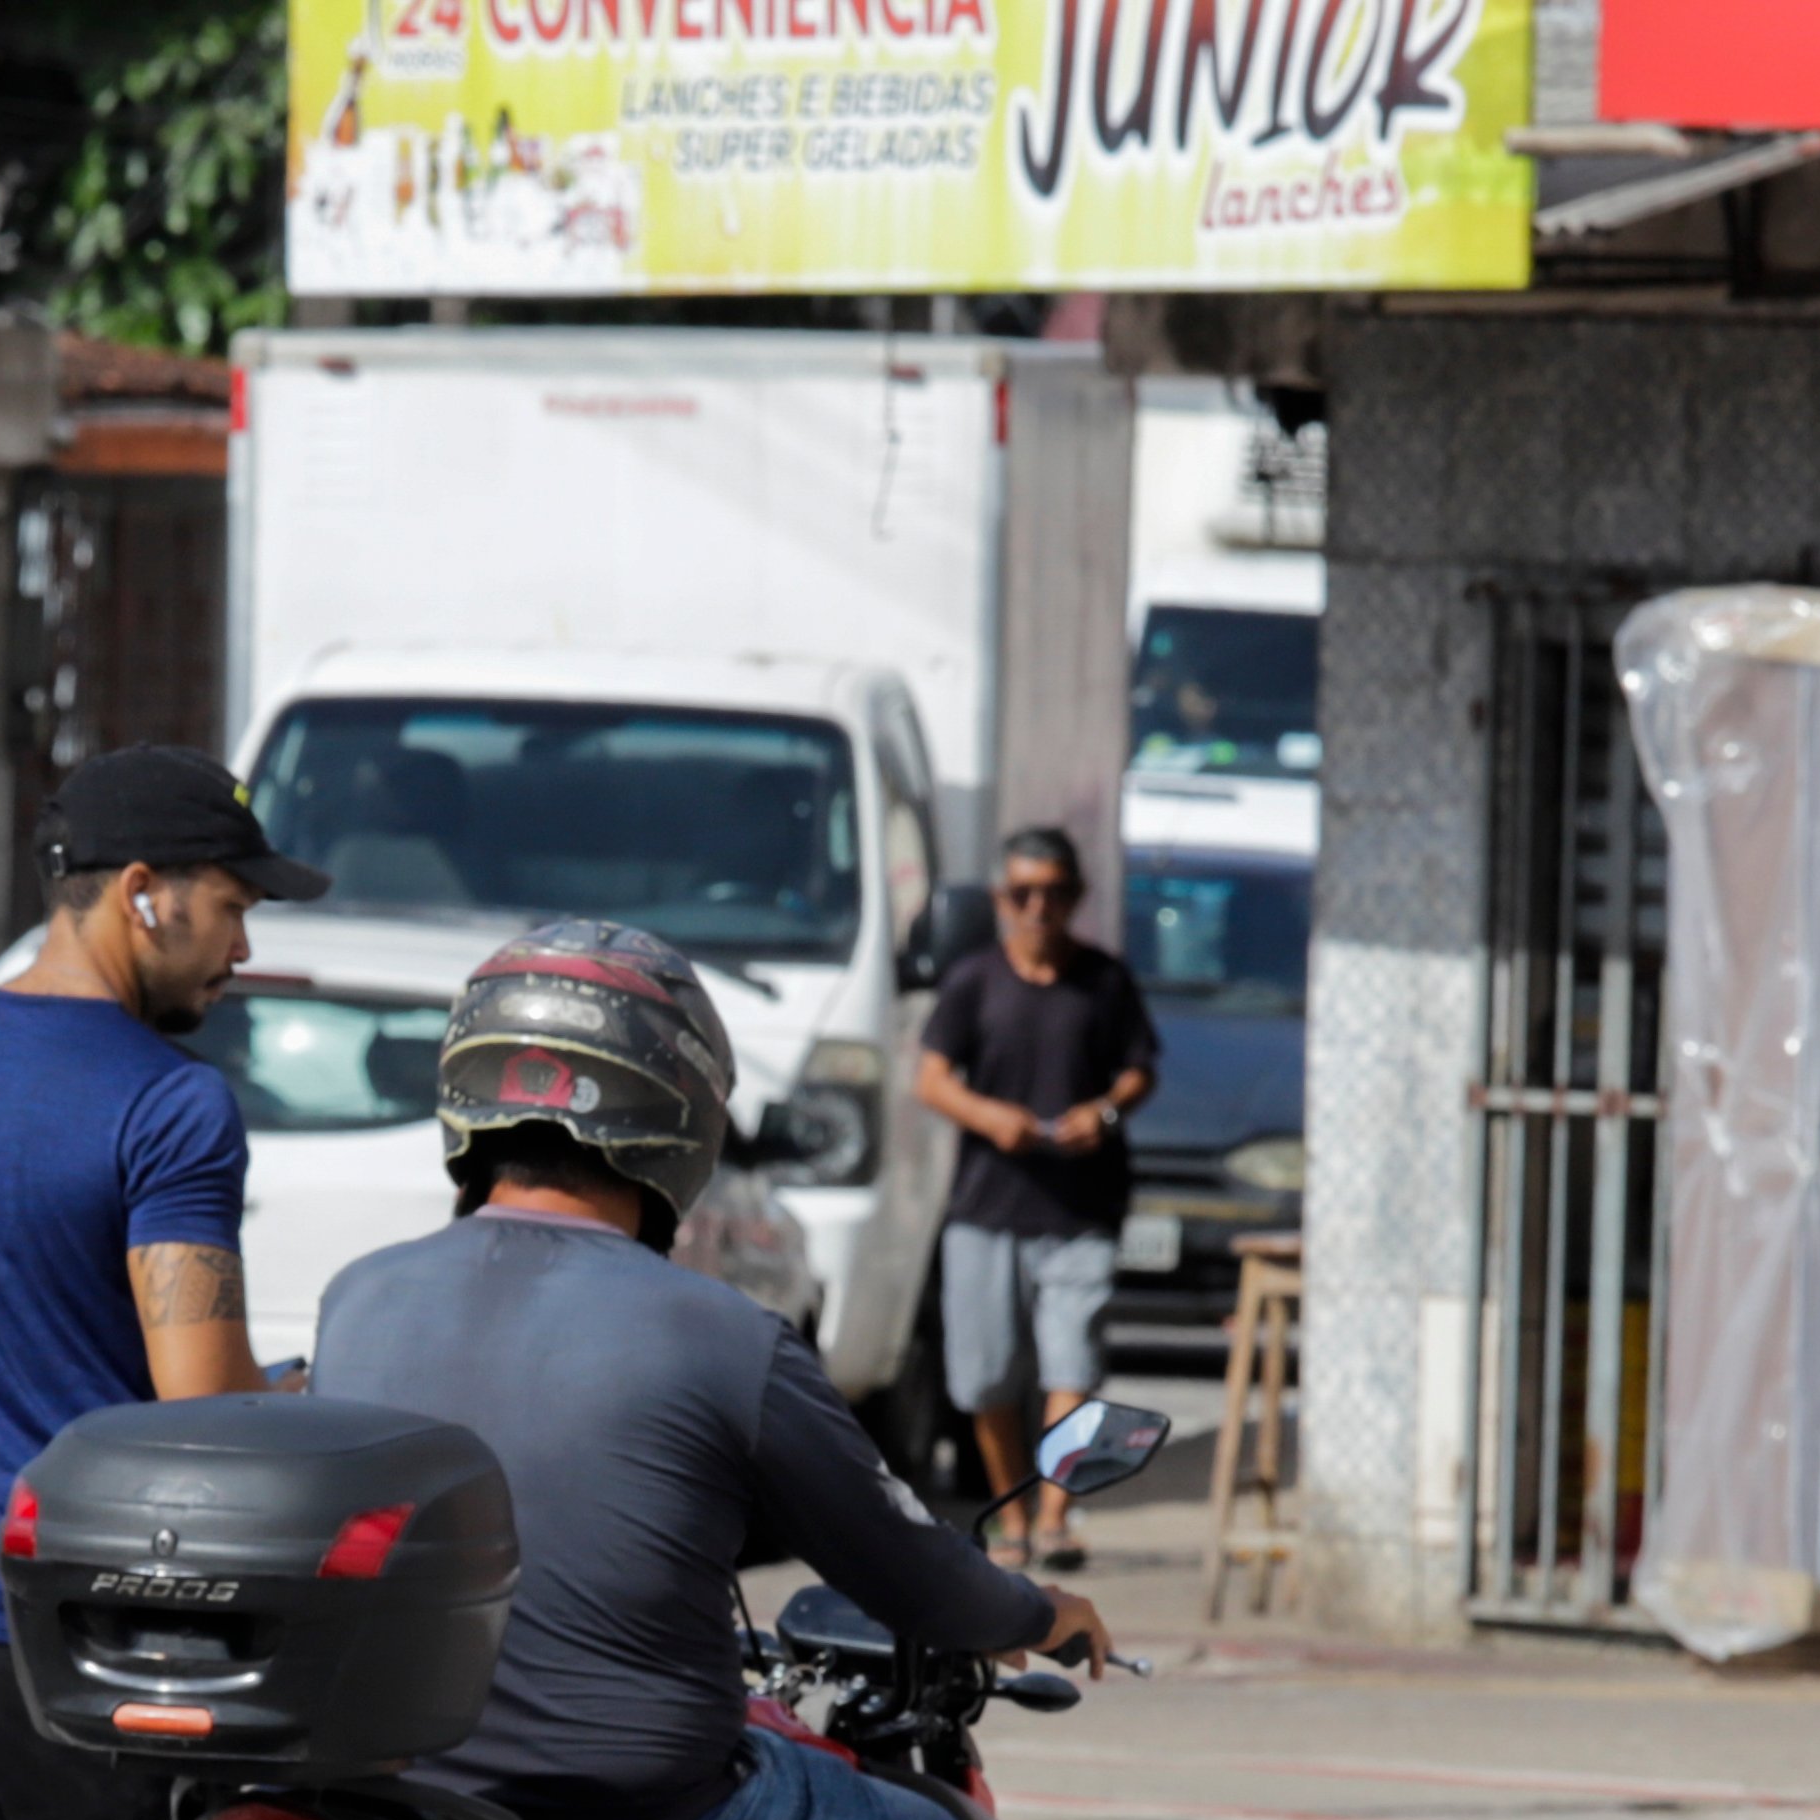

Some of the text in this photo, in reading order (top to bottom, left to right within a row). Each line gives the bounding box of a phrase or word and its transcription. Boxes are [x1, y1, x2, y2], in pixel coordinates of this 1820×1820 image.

[622, 72, 994, 119] LANCHES E BEBIDAS
[675, 126, 979, 171] SUPER GELADAS
[1199, 150, 1402, 230] lanches
